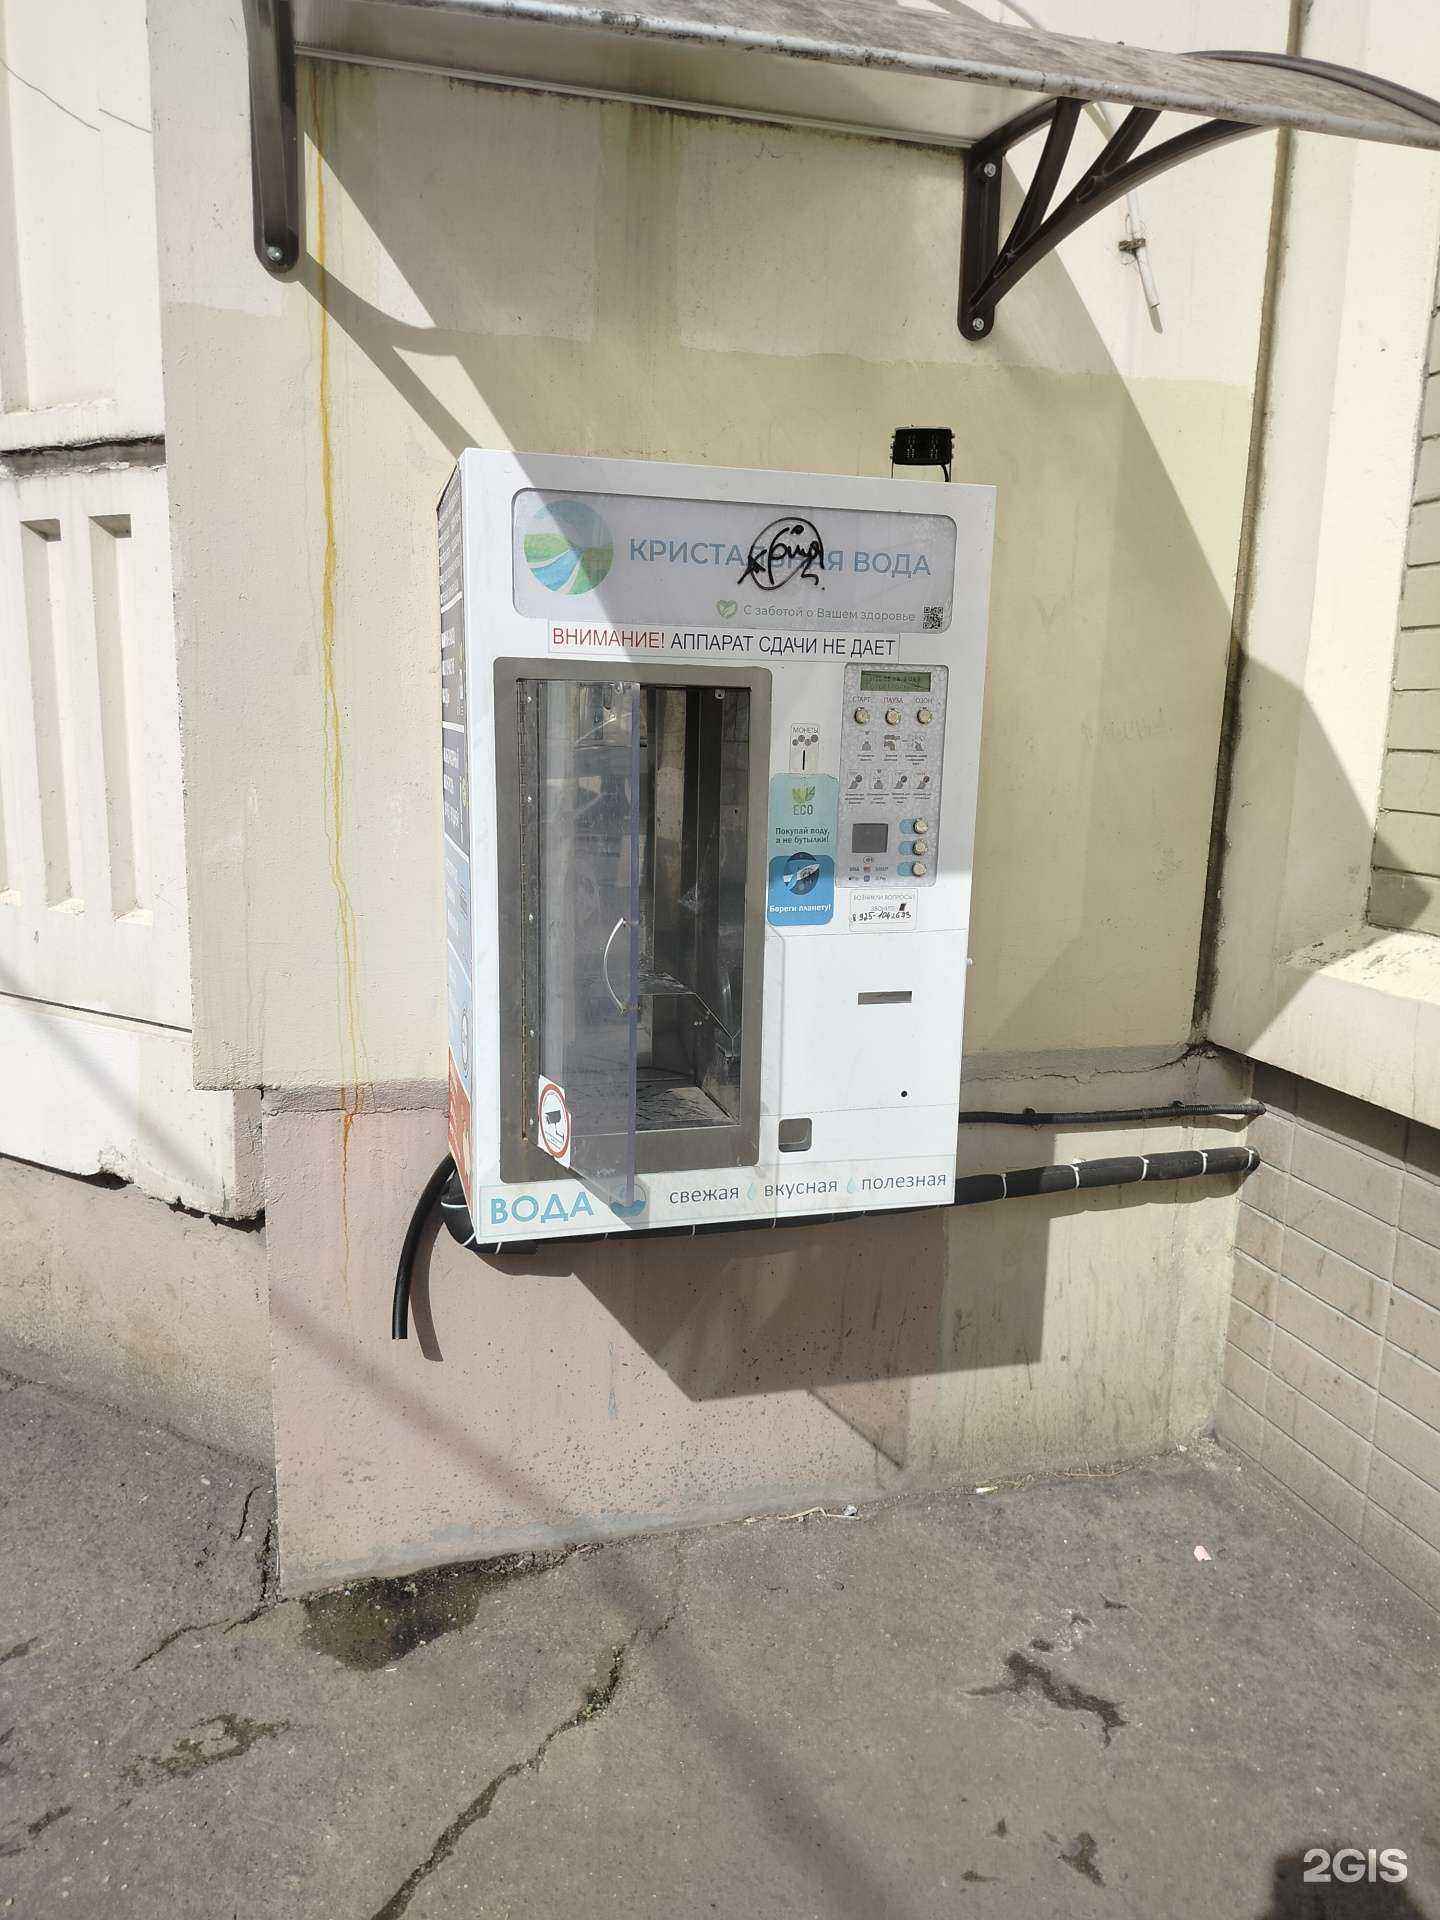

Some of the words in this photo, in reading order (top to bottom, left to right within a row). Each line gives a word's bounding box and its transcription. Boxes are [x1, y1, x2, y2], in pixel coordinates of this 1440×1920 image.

[629, 538, 843, 571] КРИСТАЯ
[853, 551, 931, 578] ВОДА
[743, 604, 752, 616] С
[755, 605, 803, 618] заботой
[806, 608, 815, 617] о
[817, 607, 858, 619] Вашем
[861, 610, 916, 623] здоровье
[553, 627, 665, 649] ВНИМАНИЕ!
[671, 632, 754, 651] АППАРАТ
[759, 635, 817, 656] СДАЧИ
[823, 638, 846, 655] НЕ
[850, 639, 896, 659] ДАЕТ
[793, 804, 814, 816] ECO
[669, 1185, 739, 1204] свежая
[764, 1178, 837, 1199] вкусная
[861, 1172, 947, 1191] полезная
[490, 1191, 594, 1225] ВОДА
